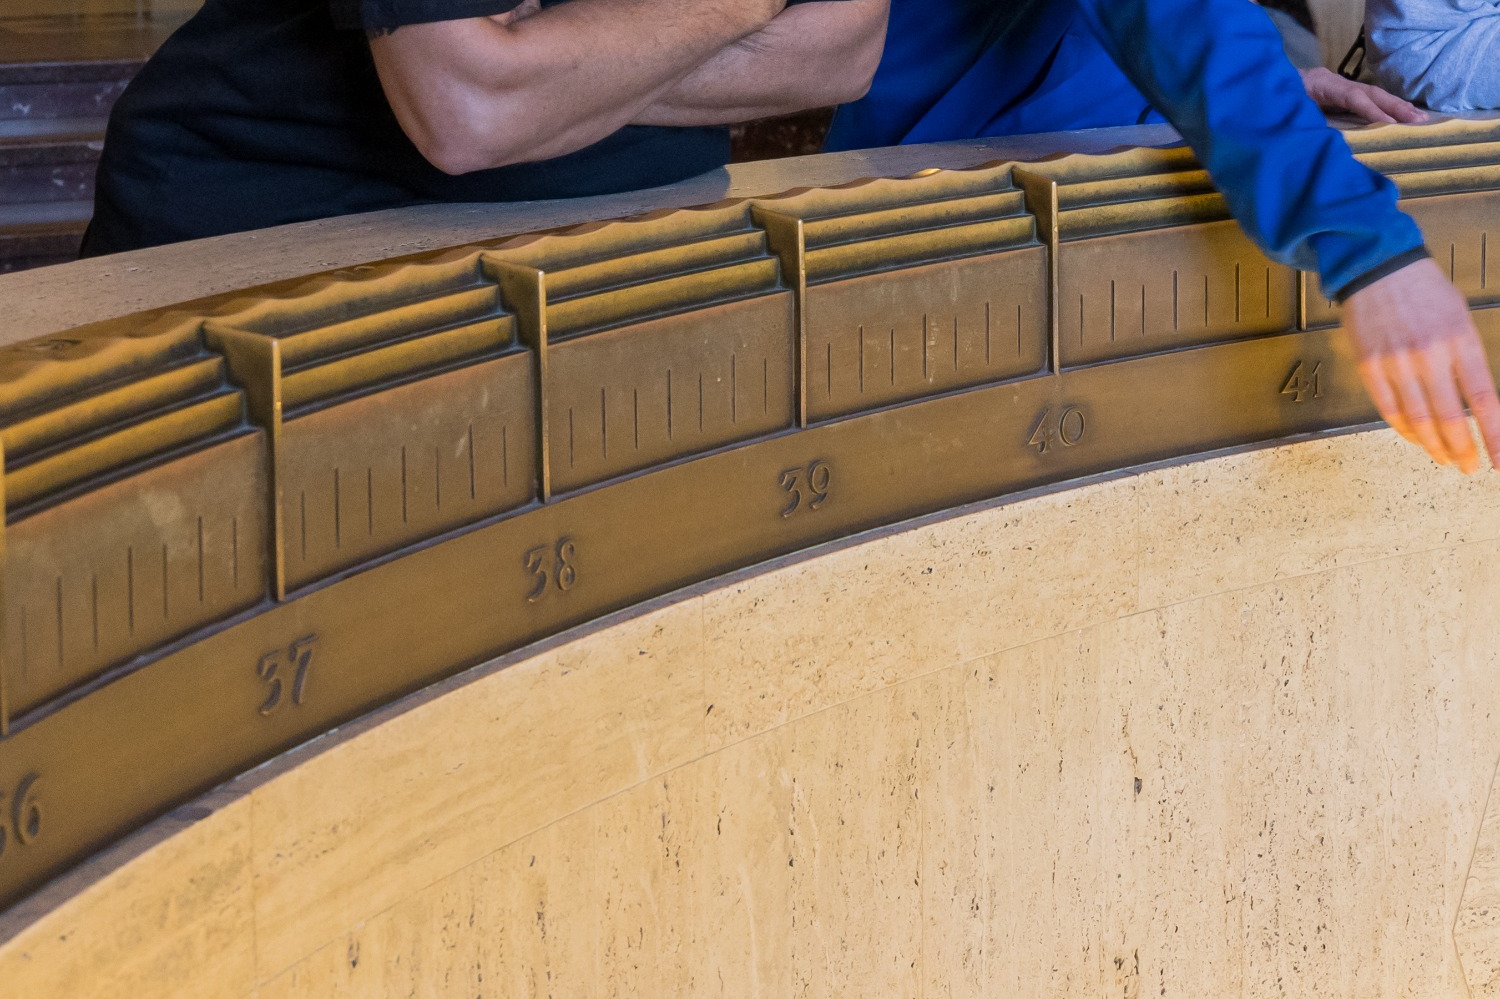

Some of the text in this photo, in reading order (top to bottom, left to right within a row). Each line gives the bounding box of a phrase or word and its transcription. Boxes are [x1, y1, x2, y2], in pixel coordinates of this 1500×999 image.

[1281, 360, 1324, 403] 41
[1026, 406, 1087, 454] 40
[780, 460, 832, 519] 39
[526, 537, 577, 604] 38
[258, 633, 319, 717] 37
[0, 773, 42, 859] 6
